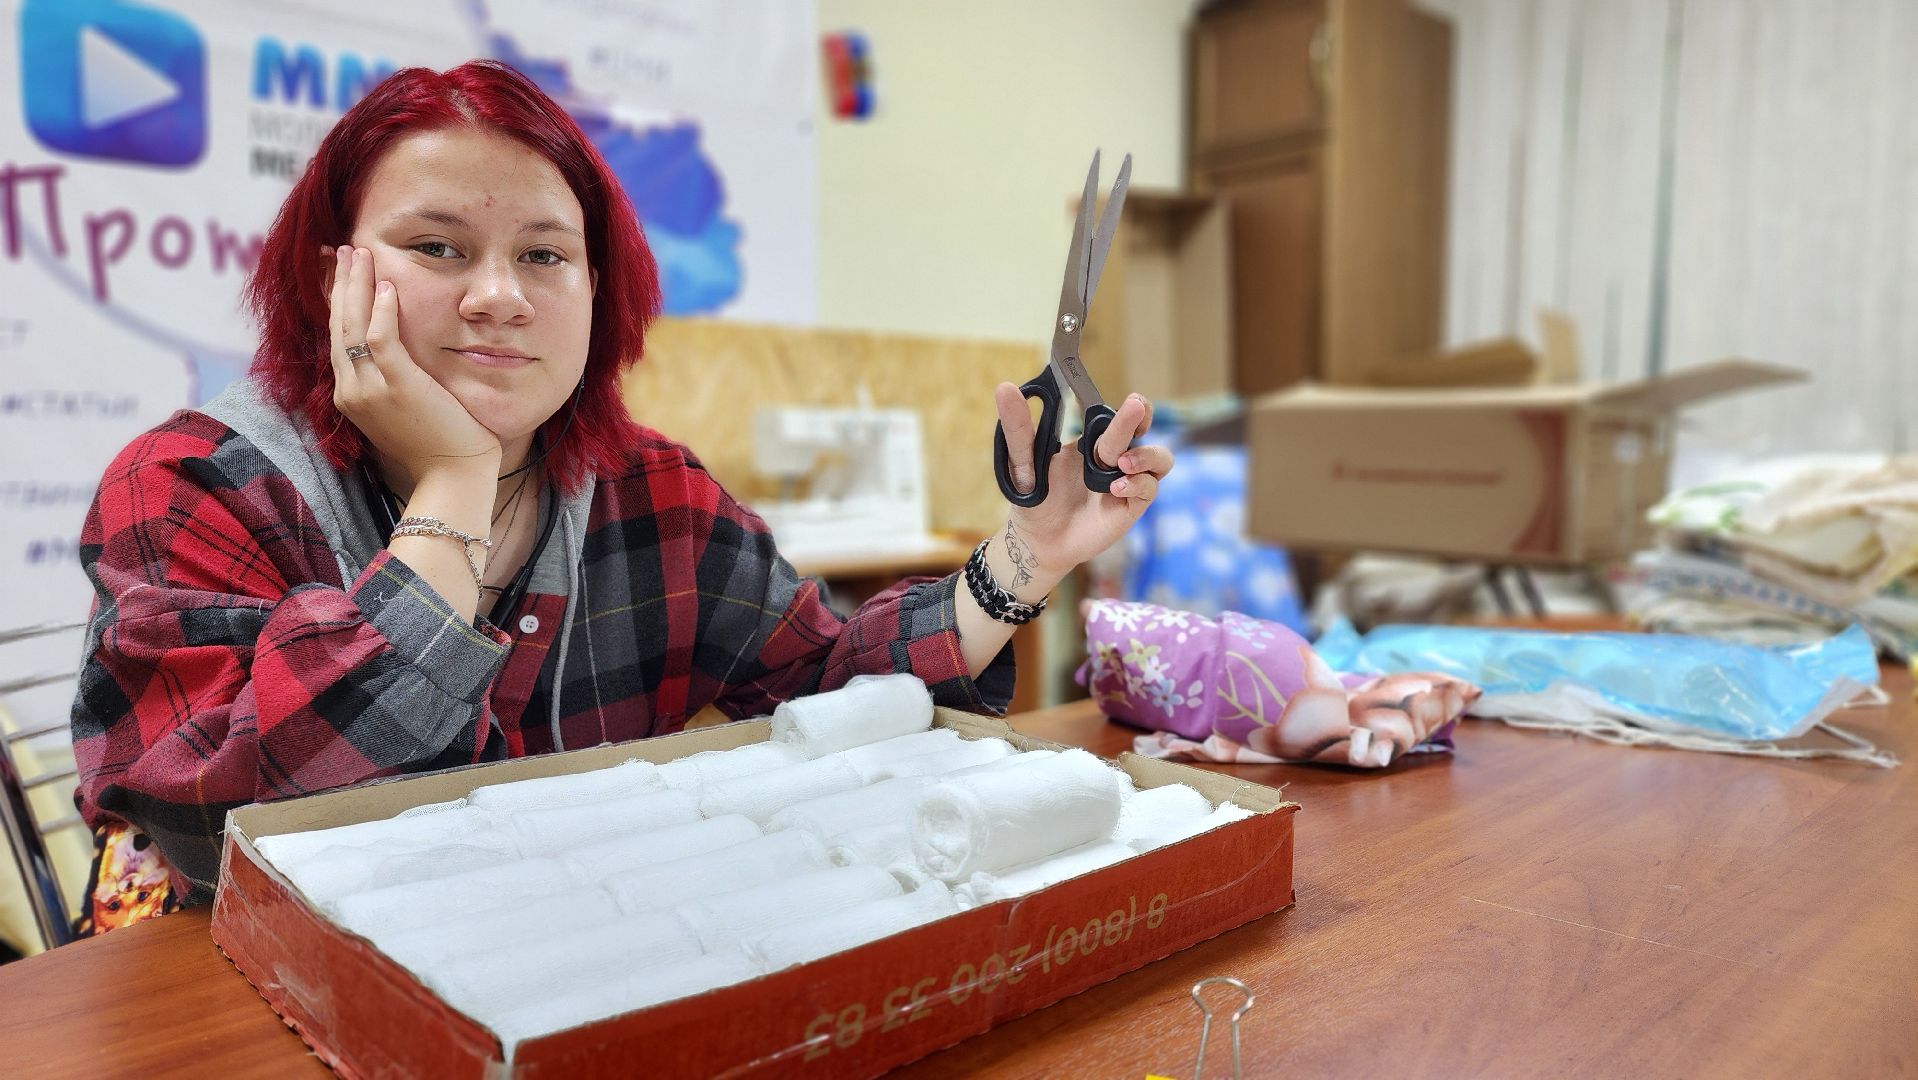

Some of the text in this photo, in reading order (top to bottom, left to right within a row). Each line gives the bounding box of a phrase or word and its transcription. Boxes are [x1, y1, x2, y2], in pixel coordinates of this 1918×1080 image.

[803, 893, 1168, 1063] 8 (800) 200 33 83
